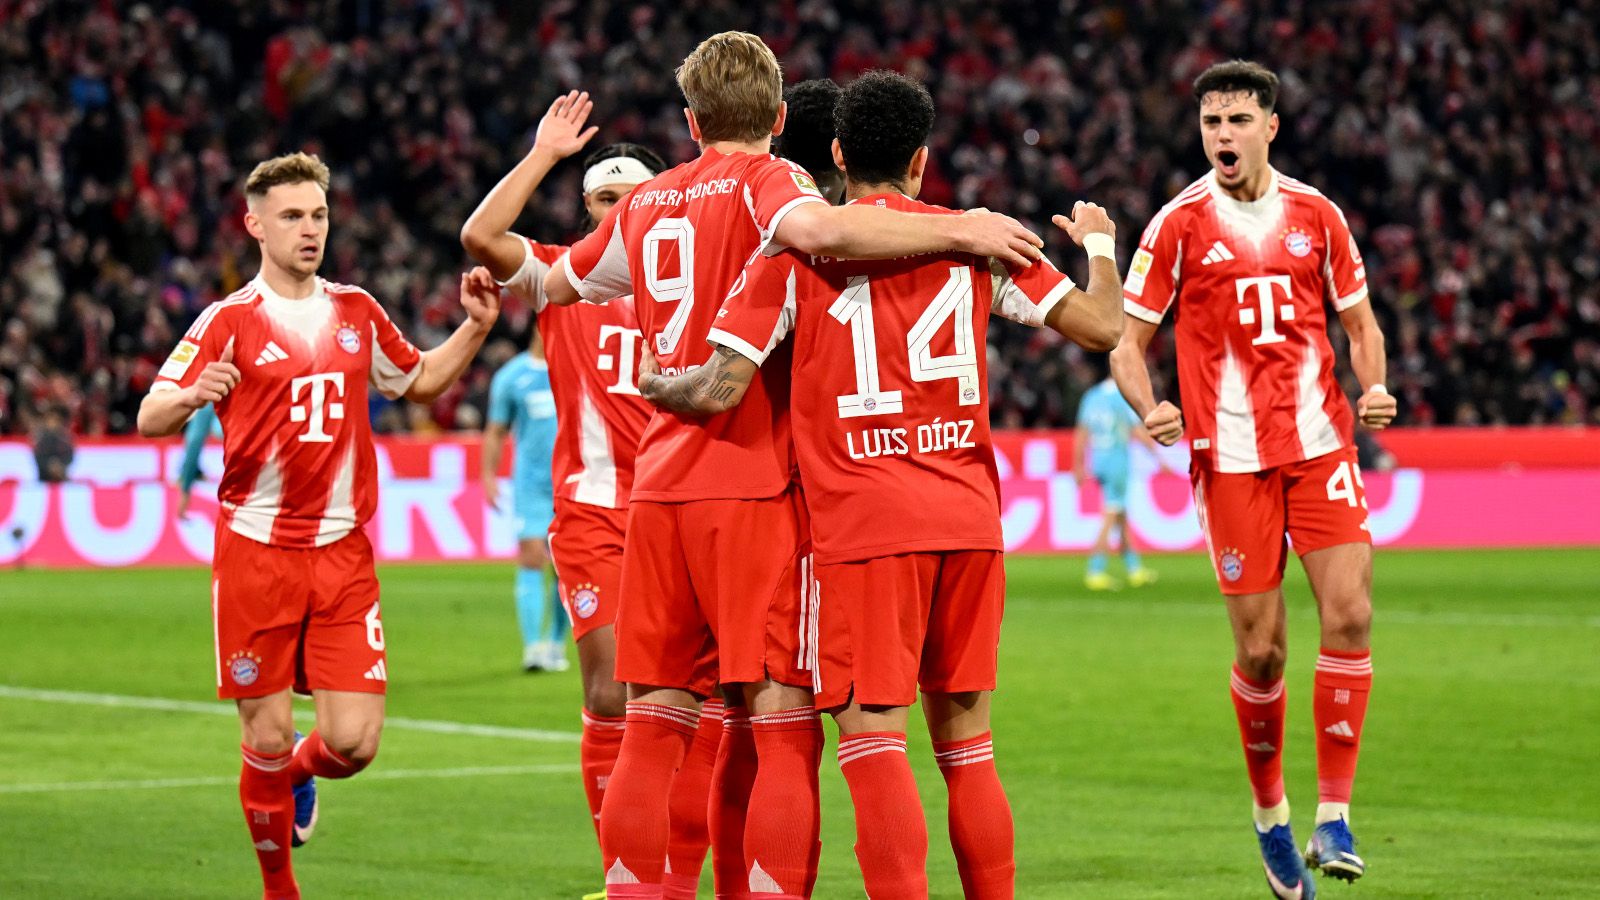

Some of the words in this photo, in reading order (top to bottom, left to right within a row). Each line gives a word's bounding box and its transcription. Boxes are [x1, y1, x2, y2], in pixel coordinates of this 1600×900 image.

[643, 216, 695, 355] 9
[828, 264, 981, 419] 14
[846, 427, 909, 460] LUIS
[917, 416, 976, 454] DÍAZ
[364, 601, 385, 651] 6
